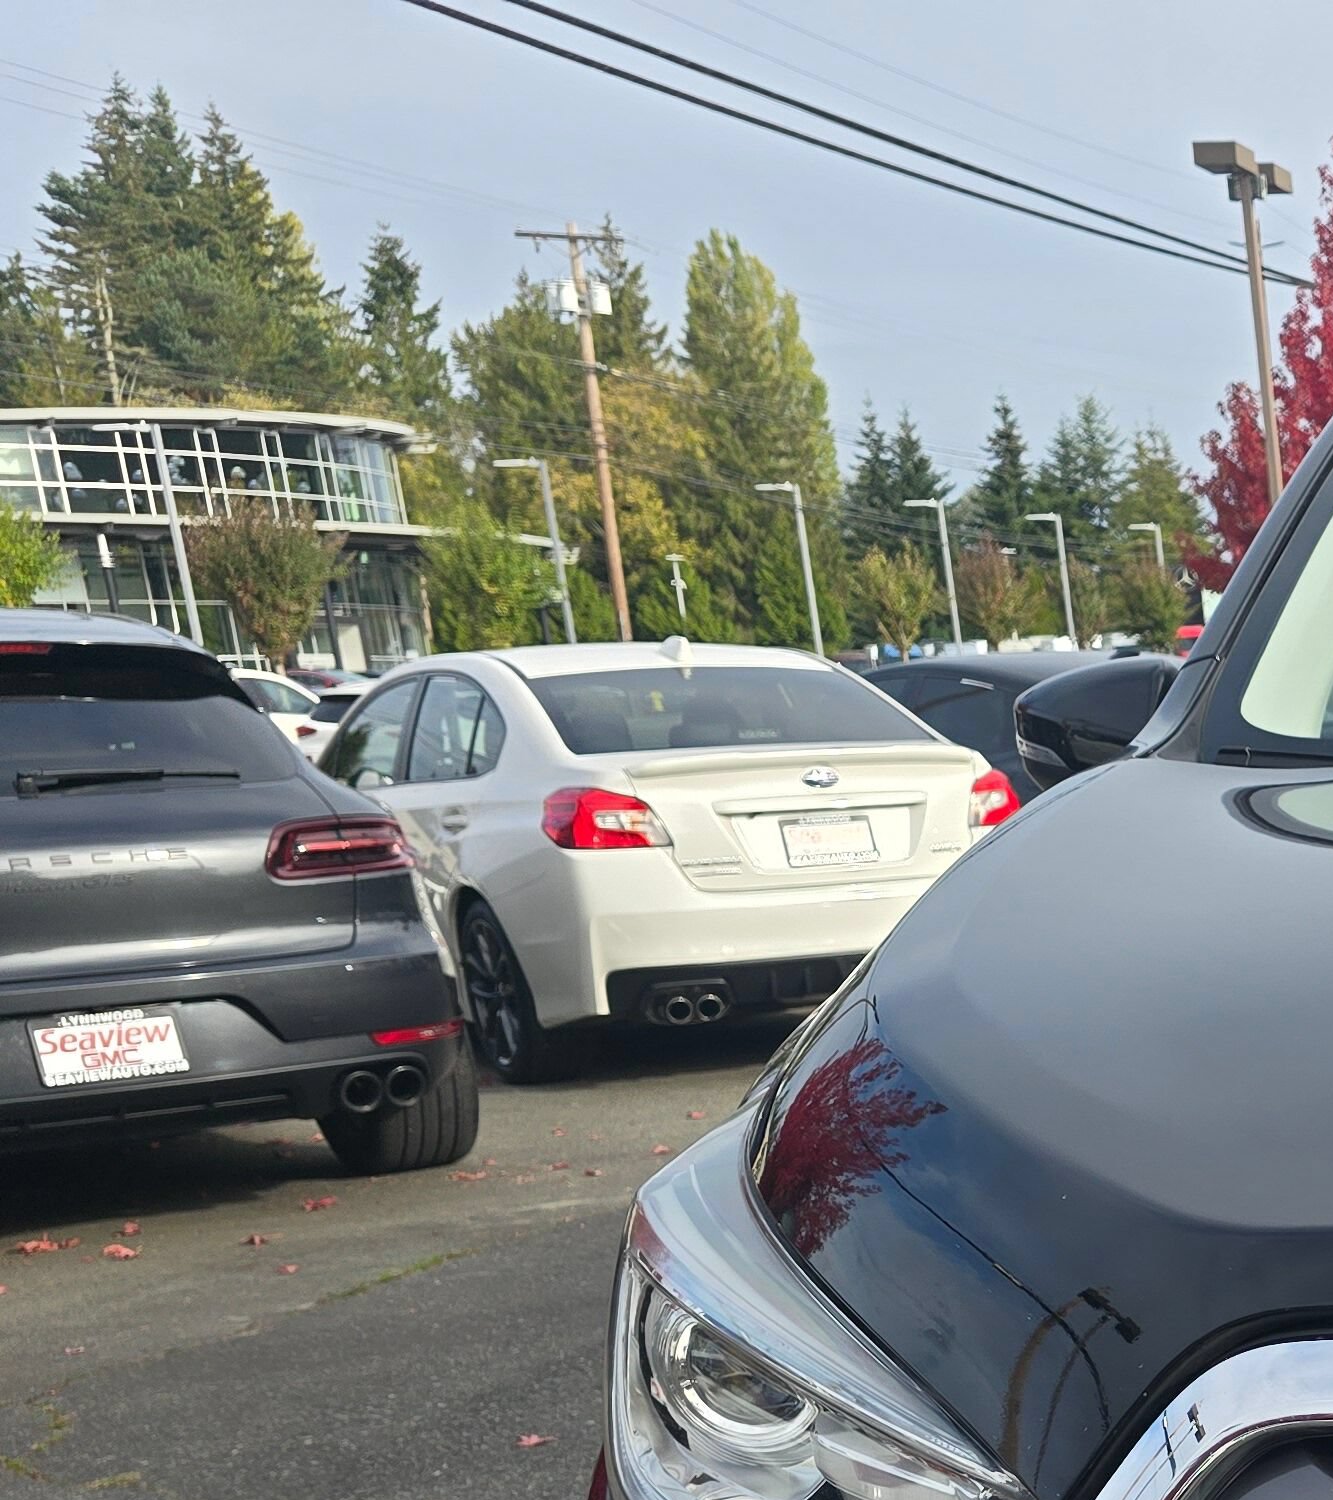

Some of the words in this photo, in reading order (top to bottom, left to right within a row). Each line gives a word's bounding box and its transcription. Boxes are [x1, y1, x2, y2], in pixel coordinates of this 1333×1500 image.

[60, 1009, 144, 1027] LYNNWOOD
[40, 1023, 171, 1056] Seaview
[81, 1048, 143, 1069] GMC
